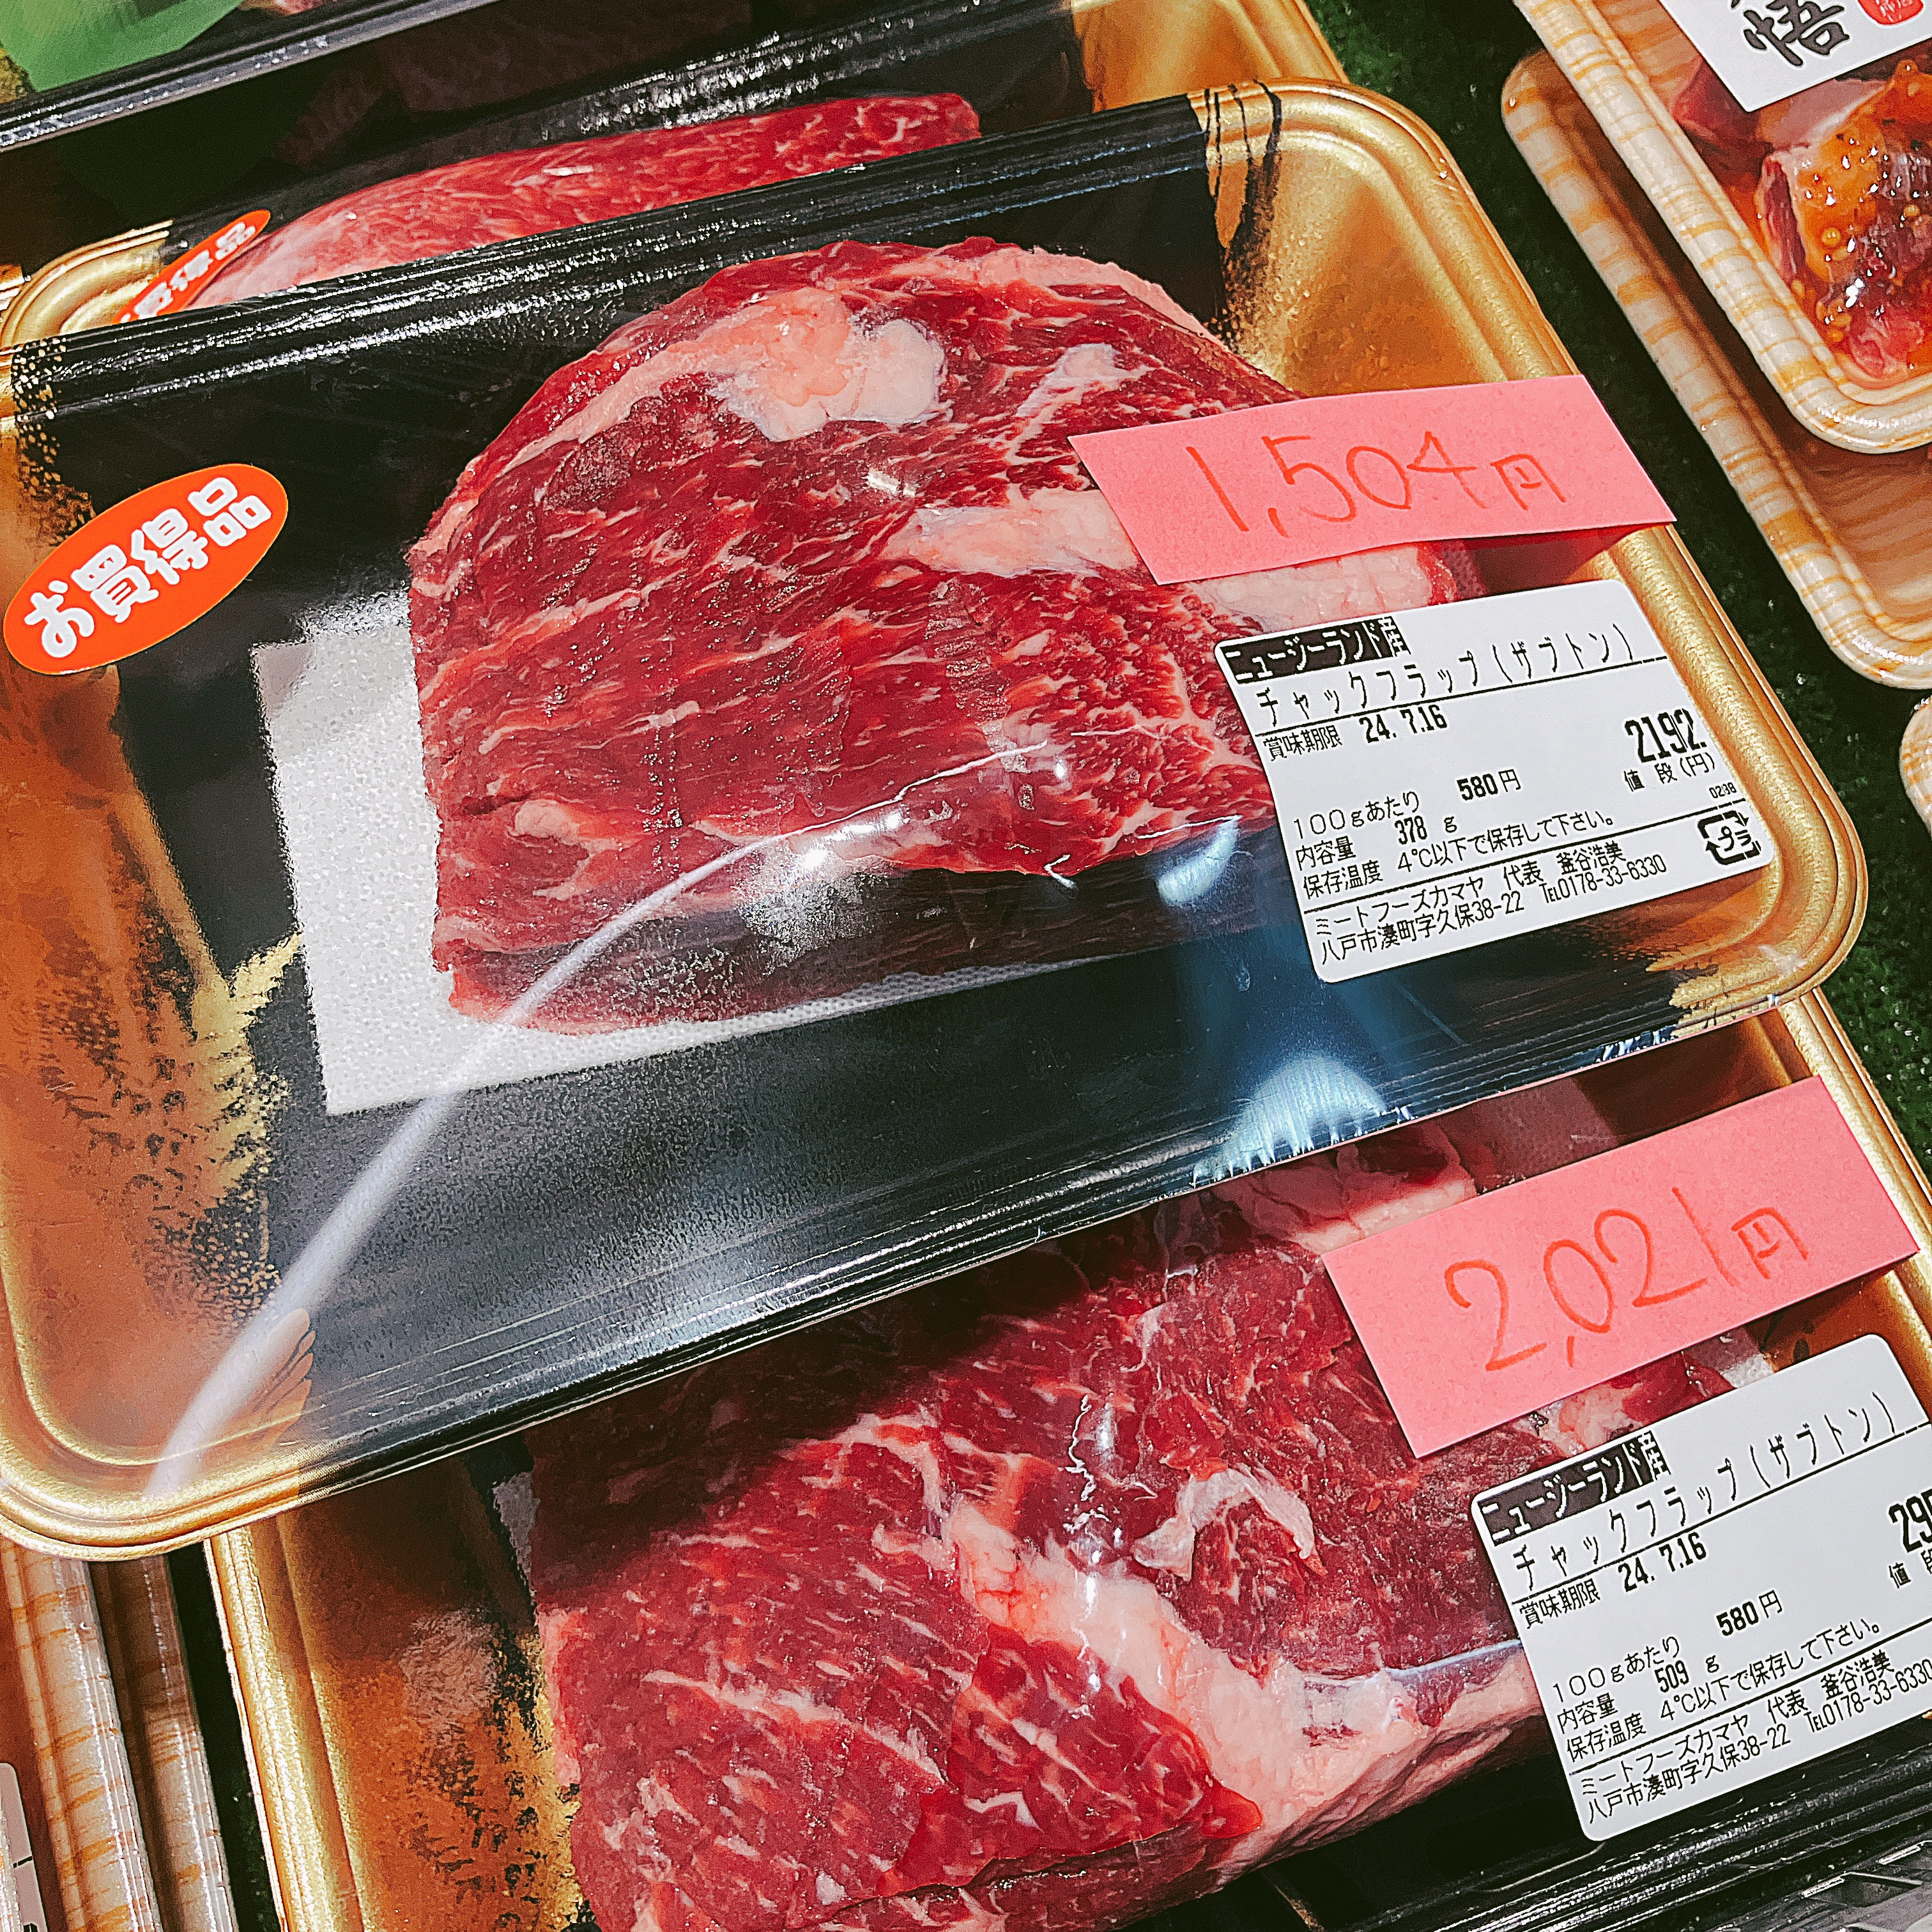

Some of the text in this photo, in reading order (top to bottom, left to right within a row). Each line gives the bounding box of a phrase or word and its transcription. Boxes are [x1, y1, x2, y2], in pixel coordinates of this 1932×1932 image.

[119, 221, 256, 319] 買得品
[1186, 430, 1566, 538] 1,504円
[24, 477, 272, 657] お買得品
[1225, 615, 1411, 680] ニュージーランド産
[1262, 725, 1342, 762] 賞味期限
[1296, 836, 1356, 871] 内容量
[1394, 815, 1427, 845] 378
[1503, 855, 1544, 890] 代表
[1303, 860, 1383, 900] 保存温度
[1444, 1186, 1809, 1372] 2,021円
[1482, 1430, 1671, 1540] ニュージーランド産
[1520, 1578, 1601, 1629] 賞味期限
[1556, 1692, 1619, 1734] 内容量
[1654, 1660, 1689, 1693] 509
[1767, 1689, 1808, 1724] 代表
[1566, 1713, 1646, 1763] 保存温度
